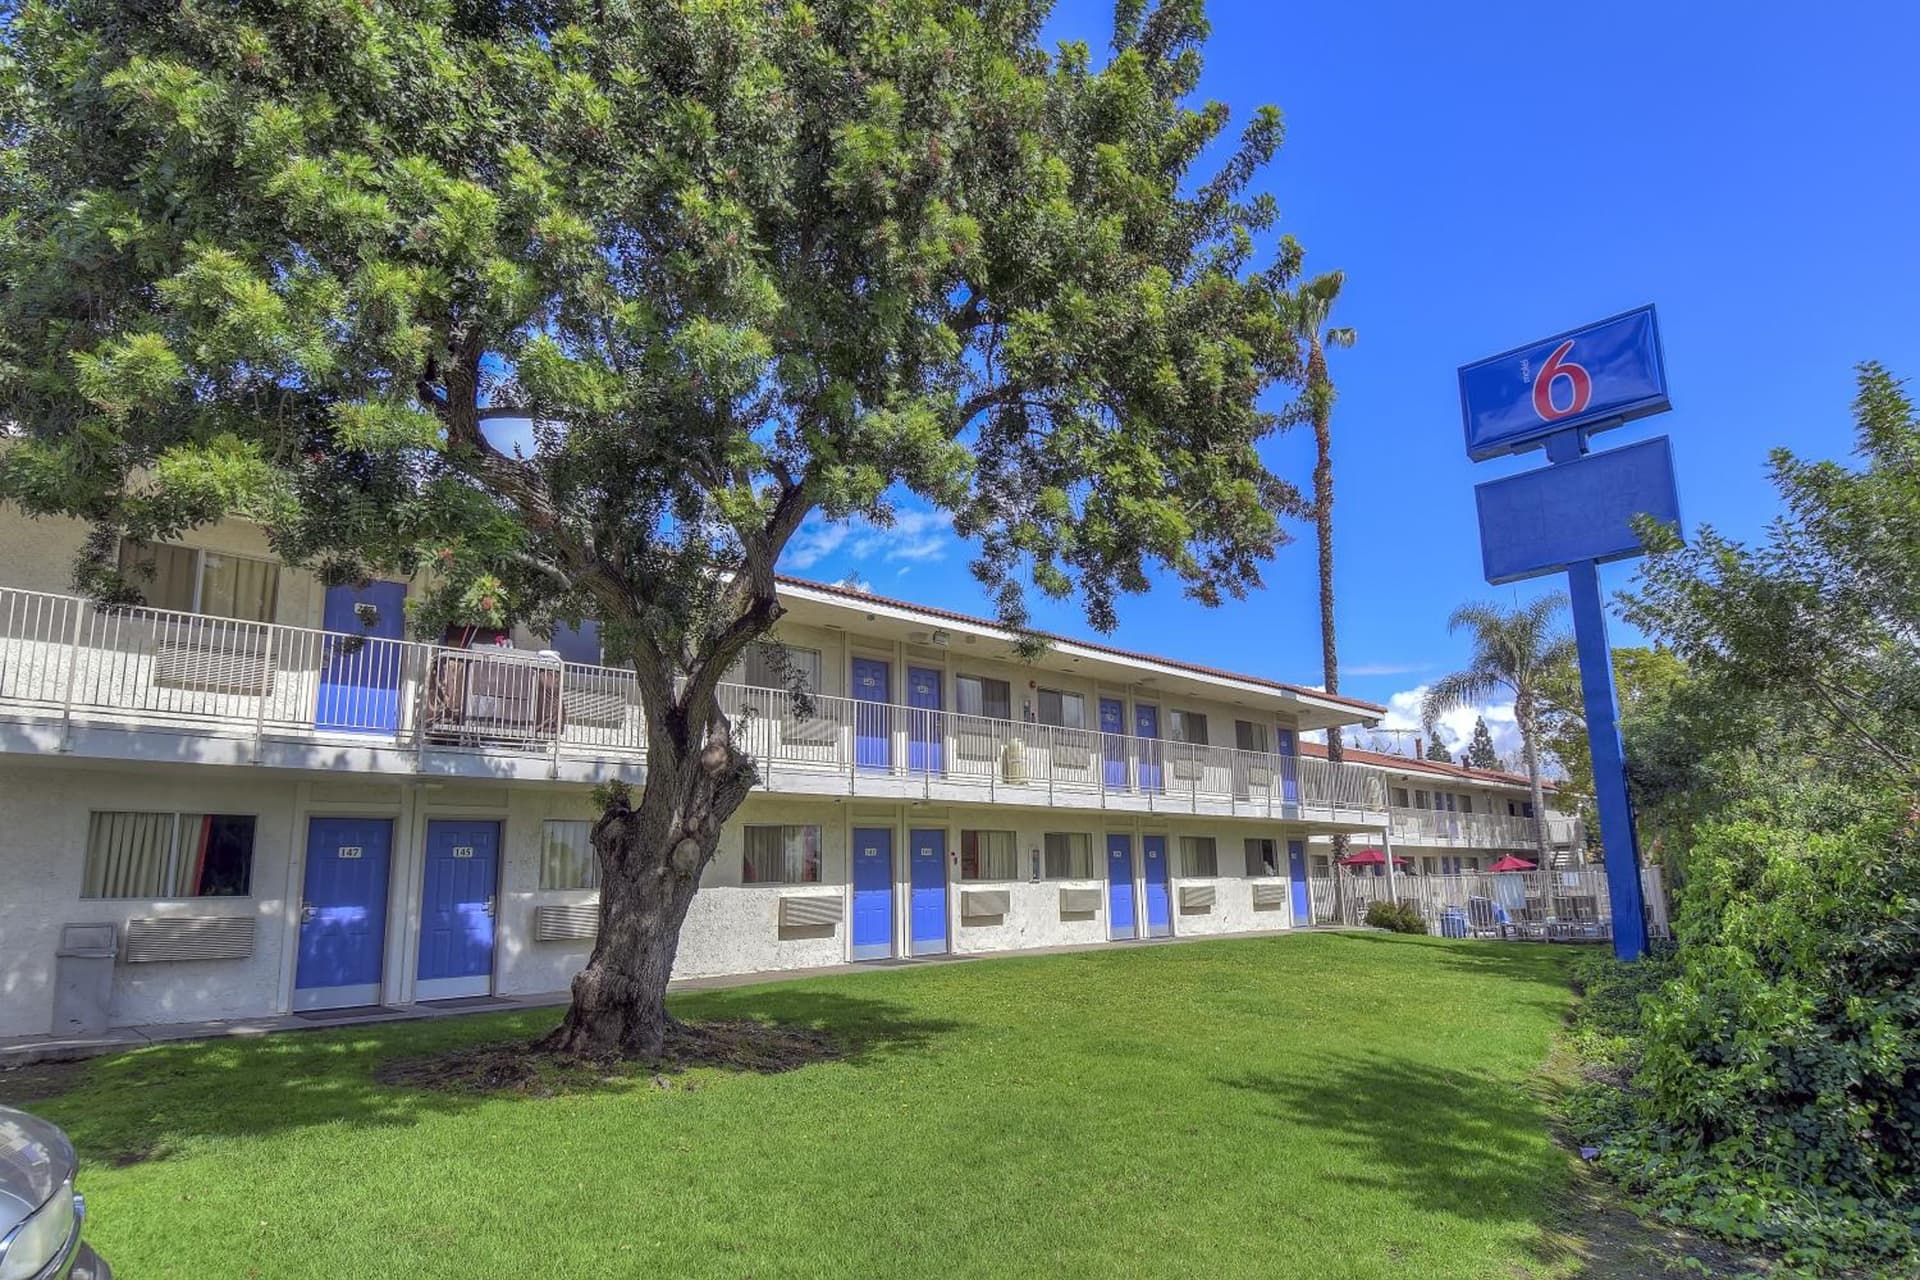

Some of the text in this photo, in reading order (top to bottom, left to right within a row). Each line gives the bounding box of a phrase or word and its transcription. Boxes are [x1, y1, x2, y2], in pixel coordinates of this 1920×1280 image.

[1532, 339, 1592, 422] 6
[341, 848, 360, 857] 147
[455, 848, 471, 857] 145
